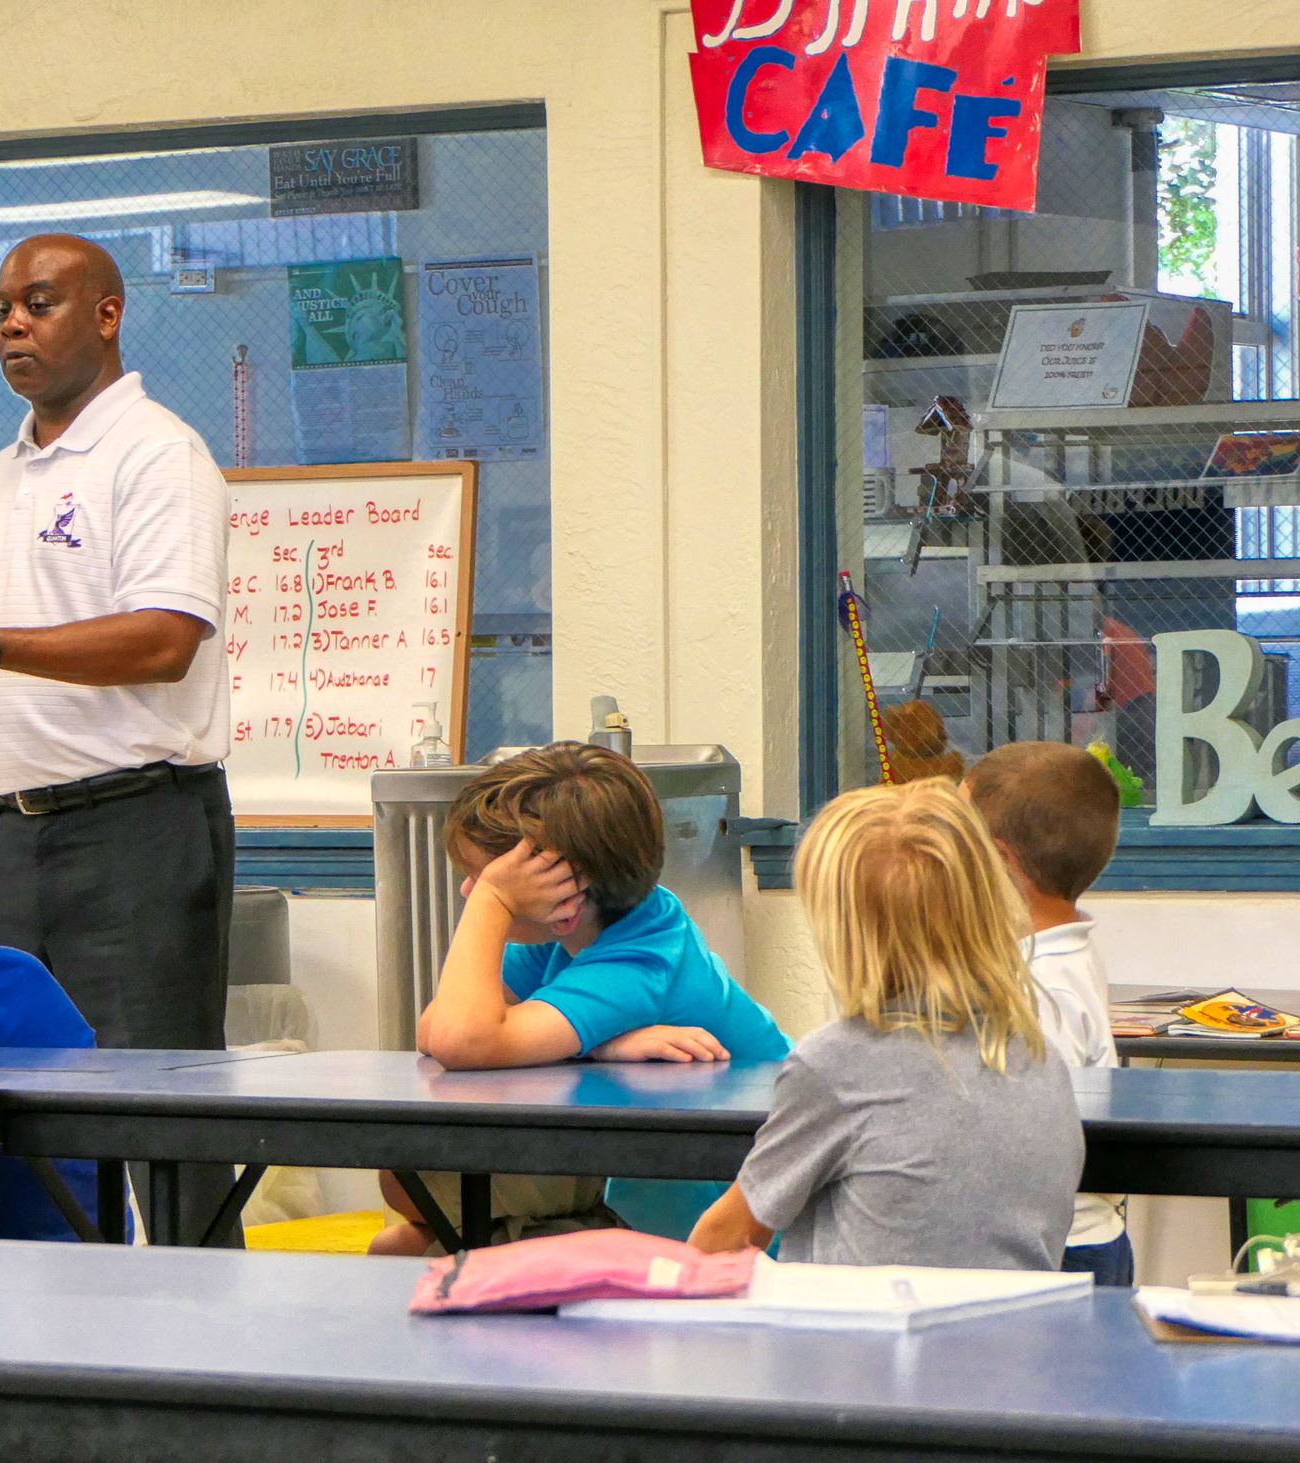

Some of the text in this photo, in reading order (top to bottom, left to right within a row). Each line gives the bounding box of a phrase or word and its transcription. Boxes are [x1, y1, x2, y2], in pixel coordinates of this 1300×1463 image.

[304, 148, 337, 173] SAY
[341, 146, 402, 170] GRACE
[274, 165, 401, 190] Eat Until You're Full
[293, 288, 321, 300] AND
[428, 271, 499, 296] Cover
[457, 291, 528, 319] Cough
[309, 311, 334, 322] ALL
[444, 386, 484, 400] Hands
[288, 503, 355, 526] Leader
[365, 498, 421, 524] Board
[317, 539, 344, 570] 3rd
[276, 574, 302, 593] 16.8
[425, 569, 447, 588] 16.1
[274, 604, 302, 622] 17.2
[317, 600, 360, 619] Jose
[424, 597, 448, 615] 16.1
[273, 632, 302, 651] 17.2
[397, 630, 408, 648] A
[422, 628, 450, 646] 16.5
[270, 671, 298, 692] 17.4
[421, 667, 436, 688] 17
[264, 717, 293, 738] 17.9
[320, 752, 379, 769] Trenton
